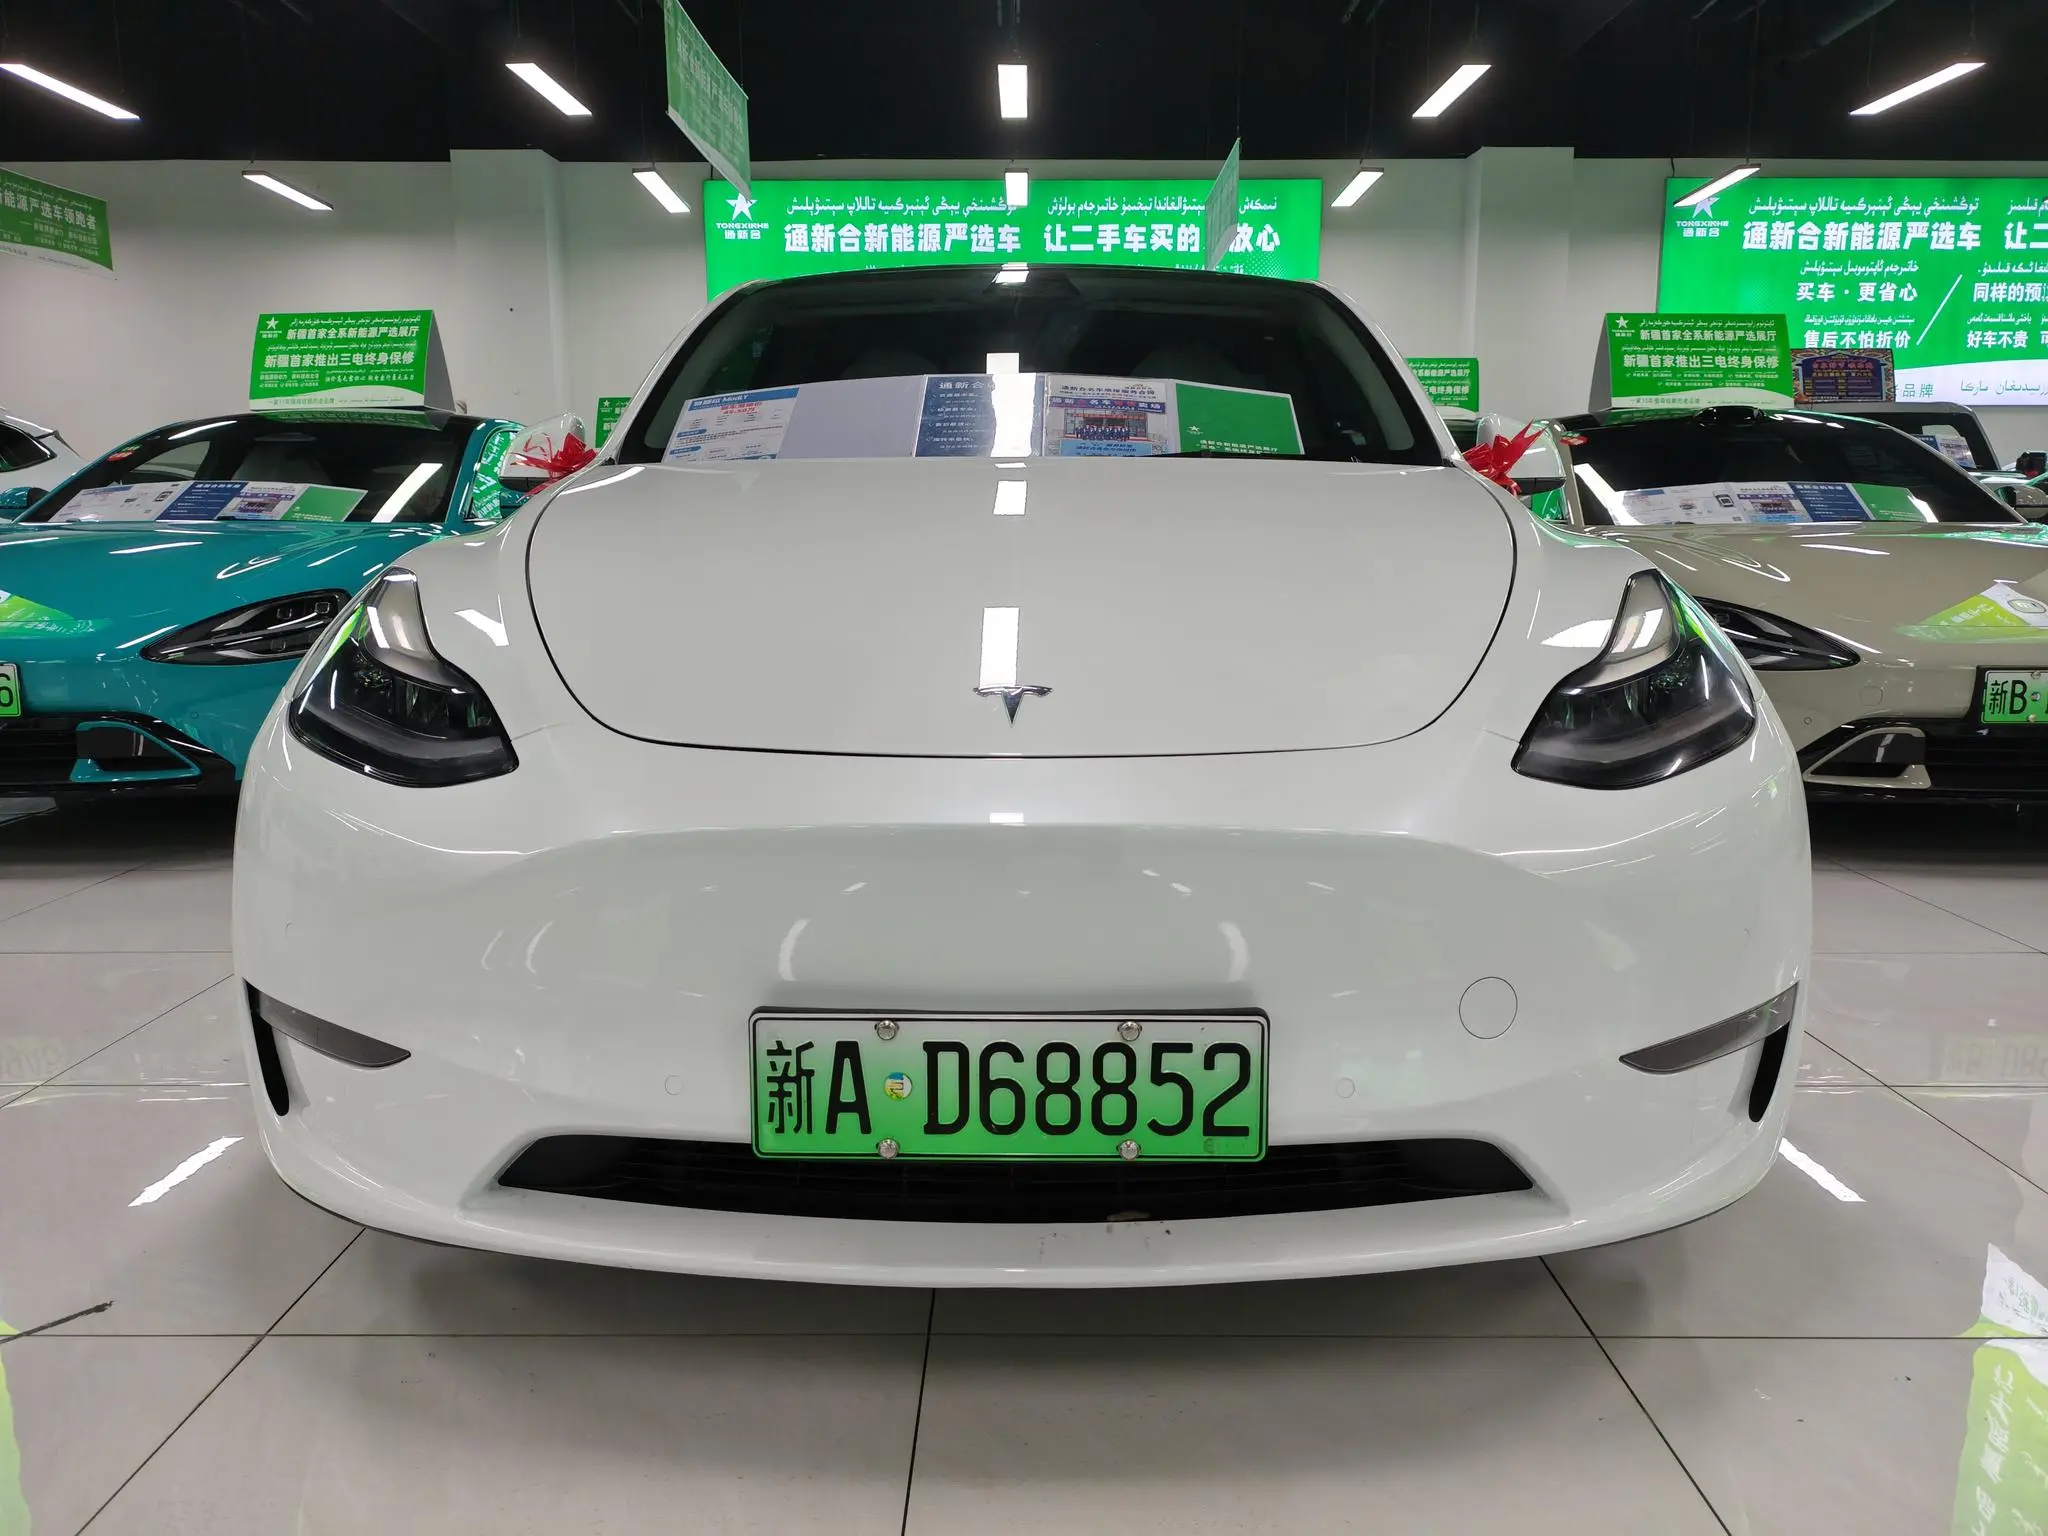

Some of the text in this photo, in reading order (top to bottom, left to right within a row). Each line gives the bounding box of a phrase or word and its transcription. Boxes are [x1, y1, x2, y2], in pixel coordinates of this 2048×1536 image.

[0, 188, 96, 231] 能源严选车领跑者
[724, 230, 761, 240] 通新合
[783, 222, 1021, 253] 通新合新能源严选车
[1043, 222, 1280, 253] 让二手车买的放心
[1682, 227, 1720, 238] 通新合
[1742, 221, 1982, 251] 通新合新能源严选车
[1803, 329, 1911, 349] 售后不怕折价
[1966, 330, 2029, 349] 好车不贵
[264, 350, 415, 368] 新疆首家推出三电终身保修
[1623, 353, 1780, 369] 新疆首家推出三电终身保修
[1895, 383, 1934, 398] 品牌
[1988, 679, 2028, 716] 新B
[765, 1039, 1252, 1138] 新A D68852
